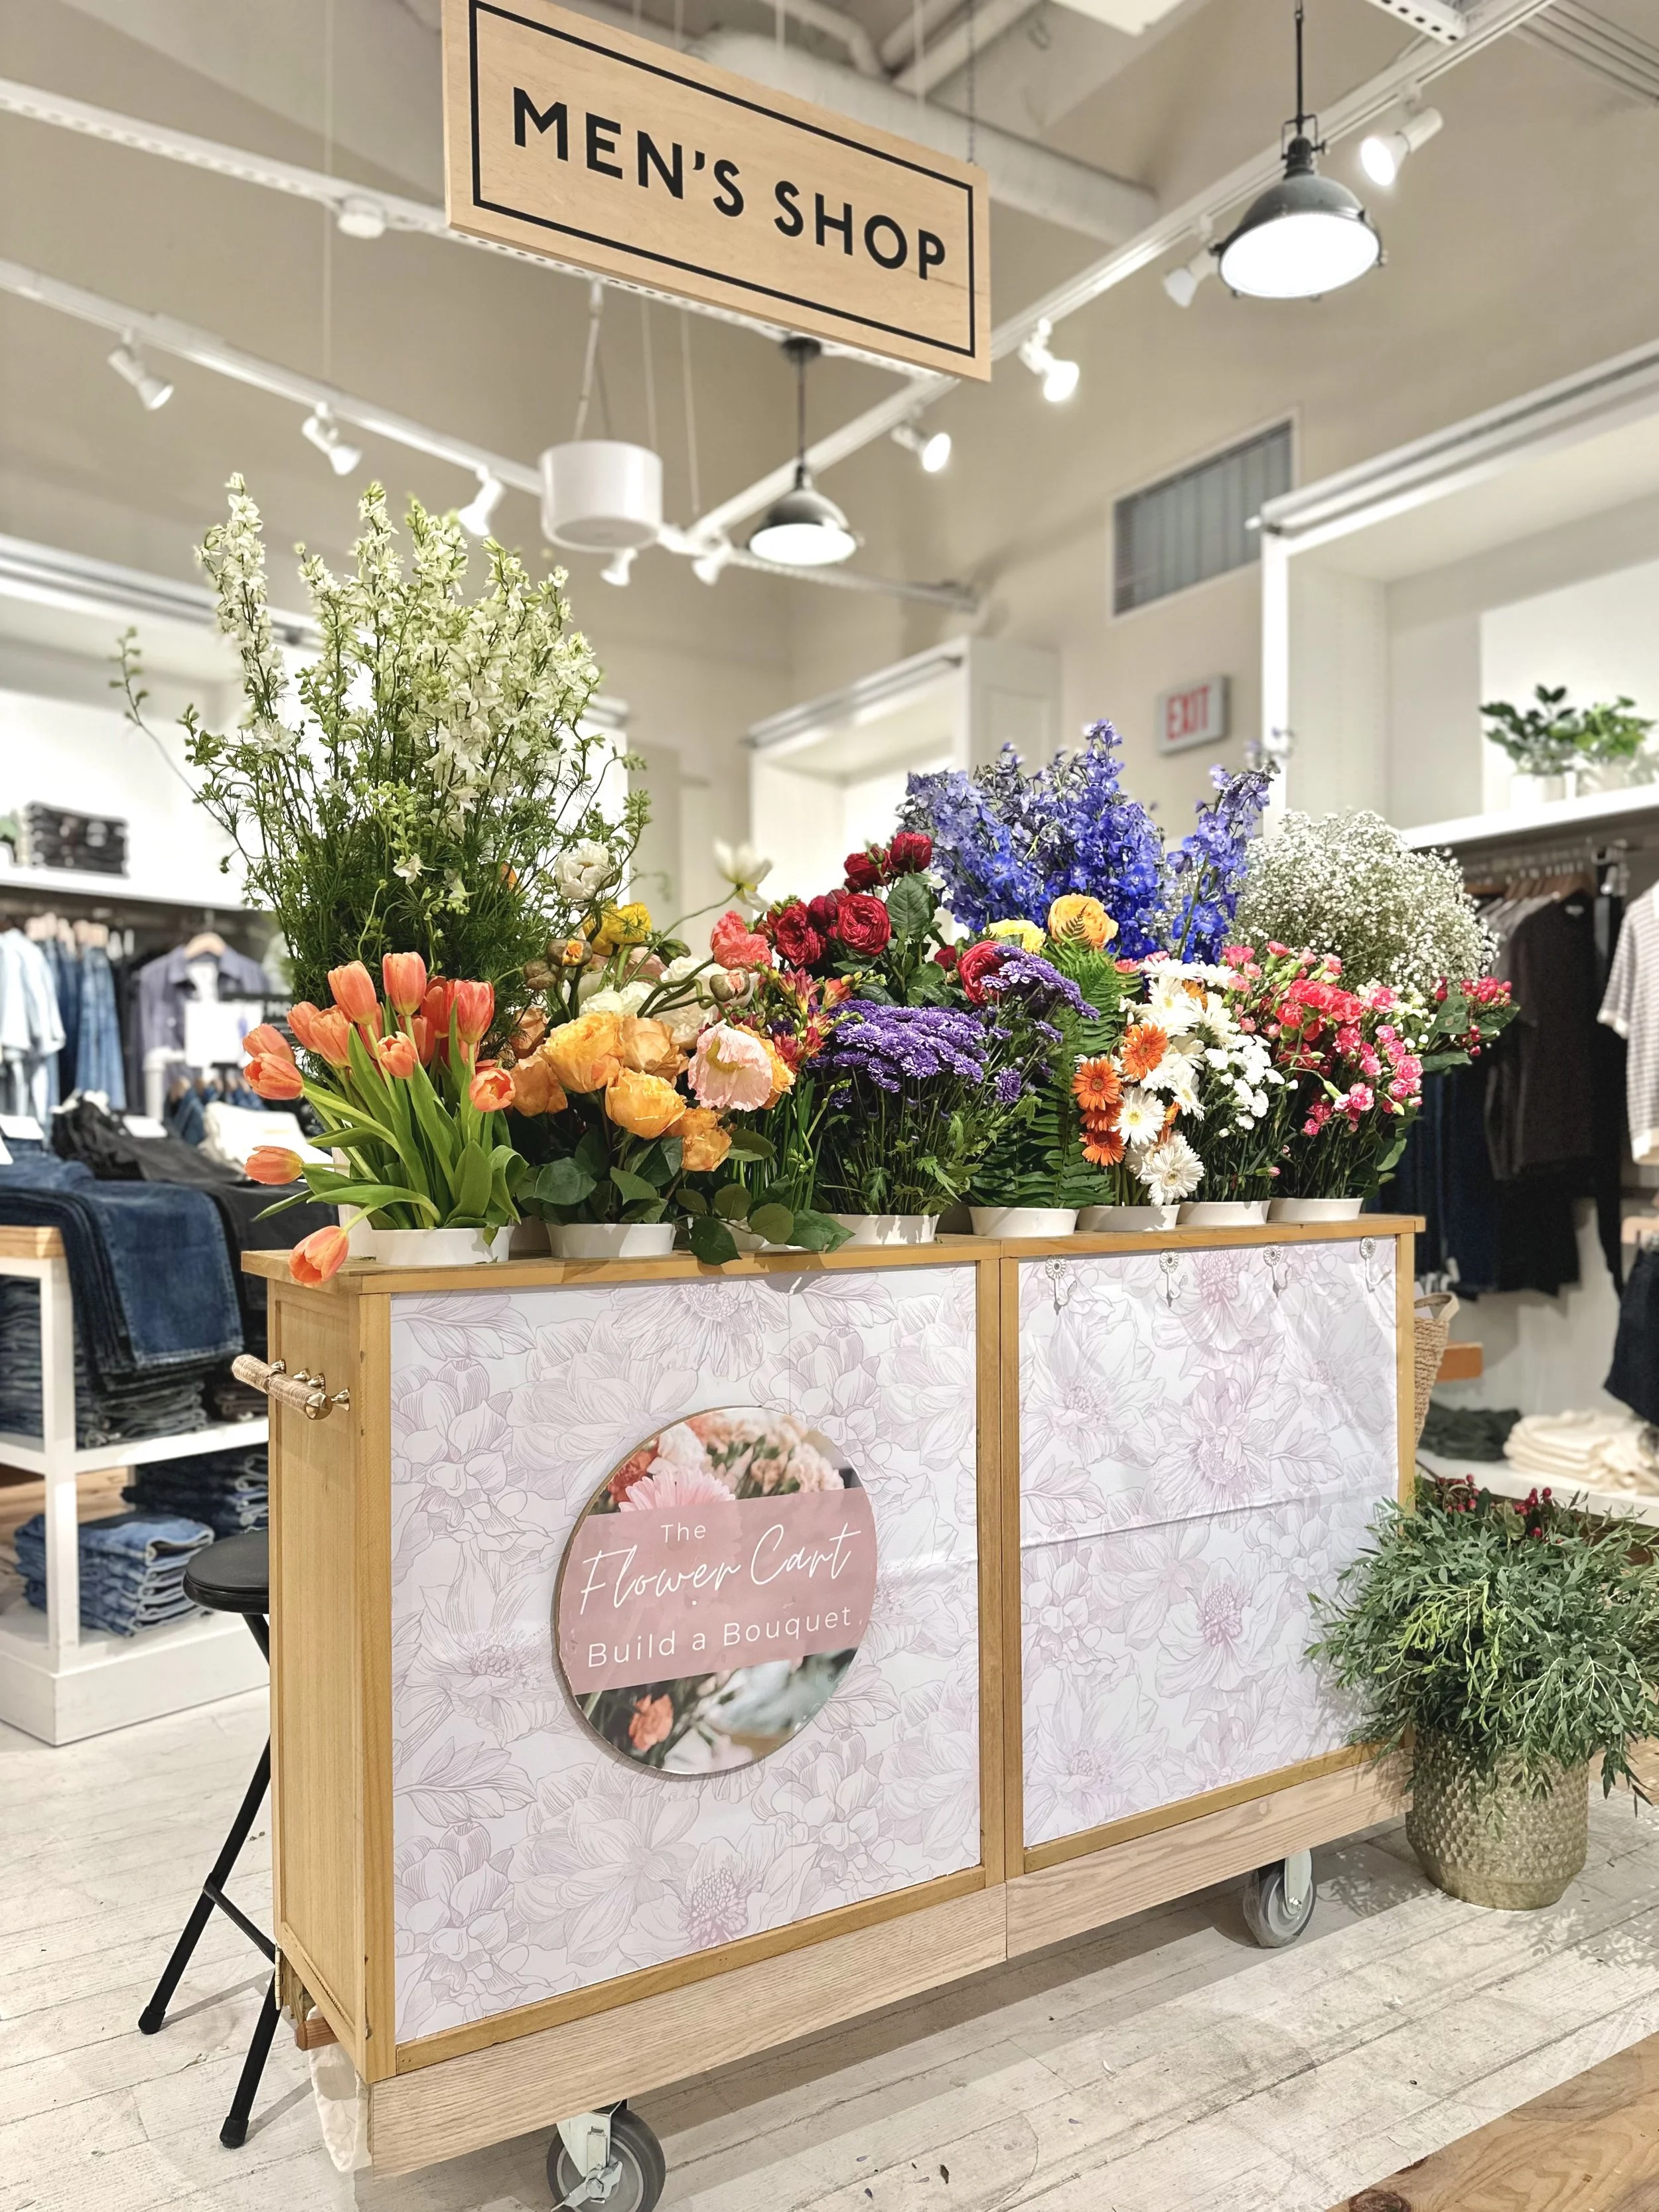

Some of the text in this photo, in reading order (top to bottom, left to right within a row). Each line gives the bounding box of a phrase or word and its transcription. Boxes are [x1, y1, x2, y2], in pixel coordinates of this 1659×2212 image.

[513, 86, 946, 281] MEN'S SHOP
[1166, 685, 1212, 741] EXIT
[660, 1522, 706, 1543] The
[579, 1522, 862, 1615] Flower Cart
[587, 1606, 851, 1668] Build a Bouquet
